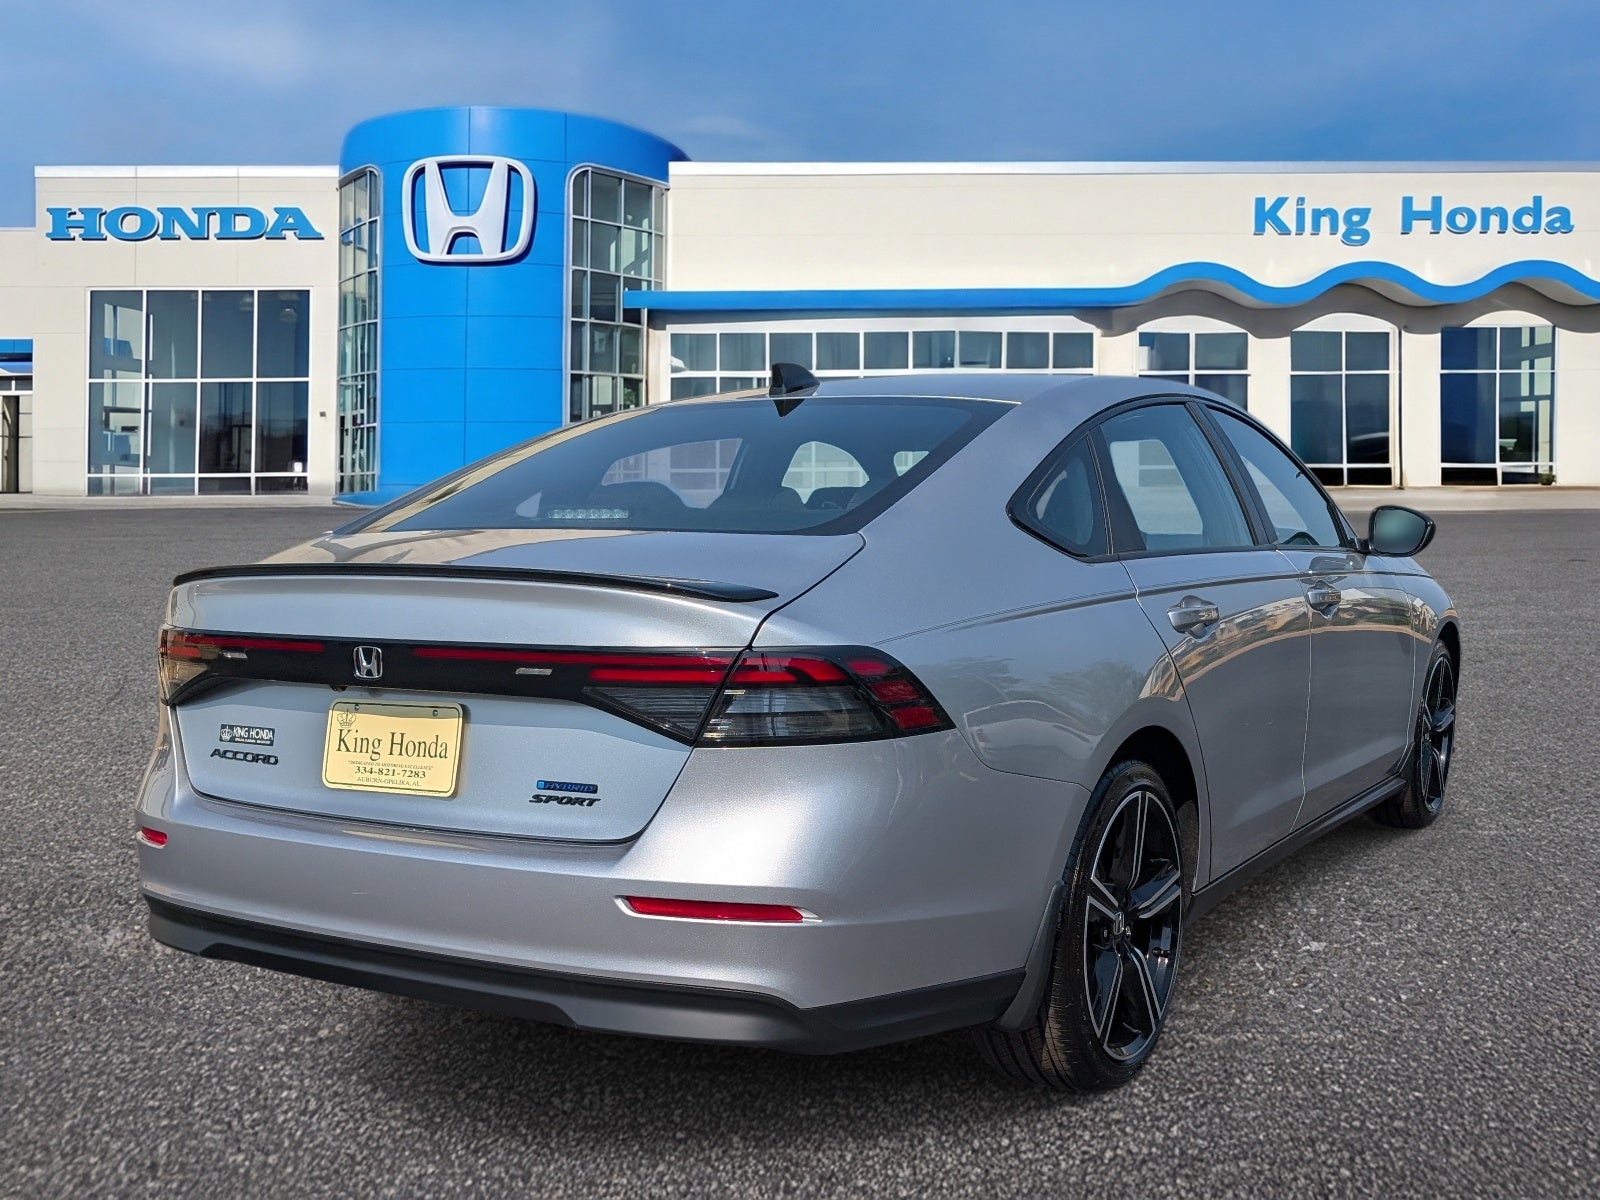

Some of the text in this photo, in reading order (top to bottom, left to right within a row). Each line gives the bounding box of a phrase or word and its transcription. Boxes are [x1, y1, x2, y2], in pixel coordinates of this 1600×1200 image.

[46, 206, 325, 241] HONDA
[1253, 195, 1575, 246] King Honda
[233, 726, 274, 740] KING HONDA
[336, 728, 448, 761] King Honda
[210, 748, 279, 765] ACCORD
[355, 766, 426, 778] 334-821-7283
[545, 782, 594, 792] HYBRID
[528, 794, 601, 807] SPORT
